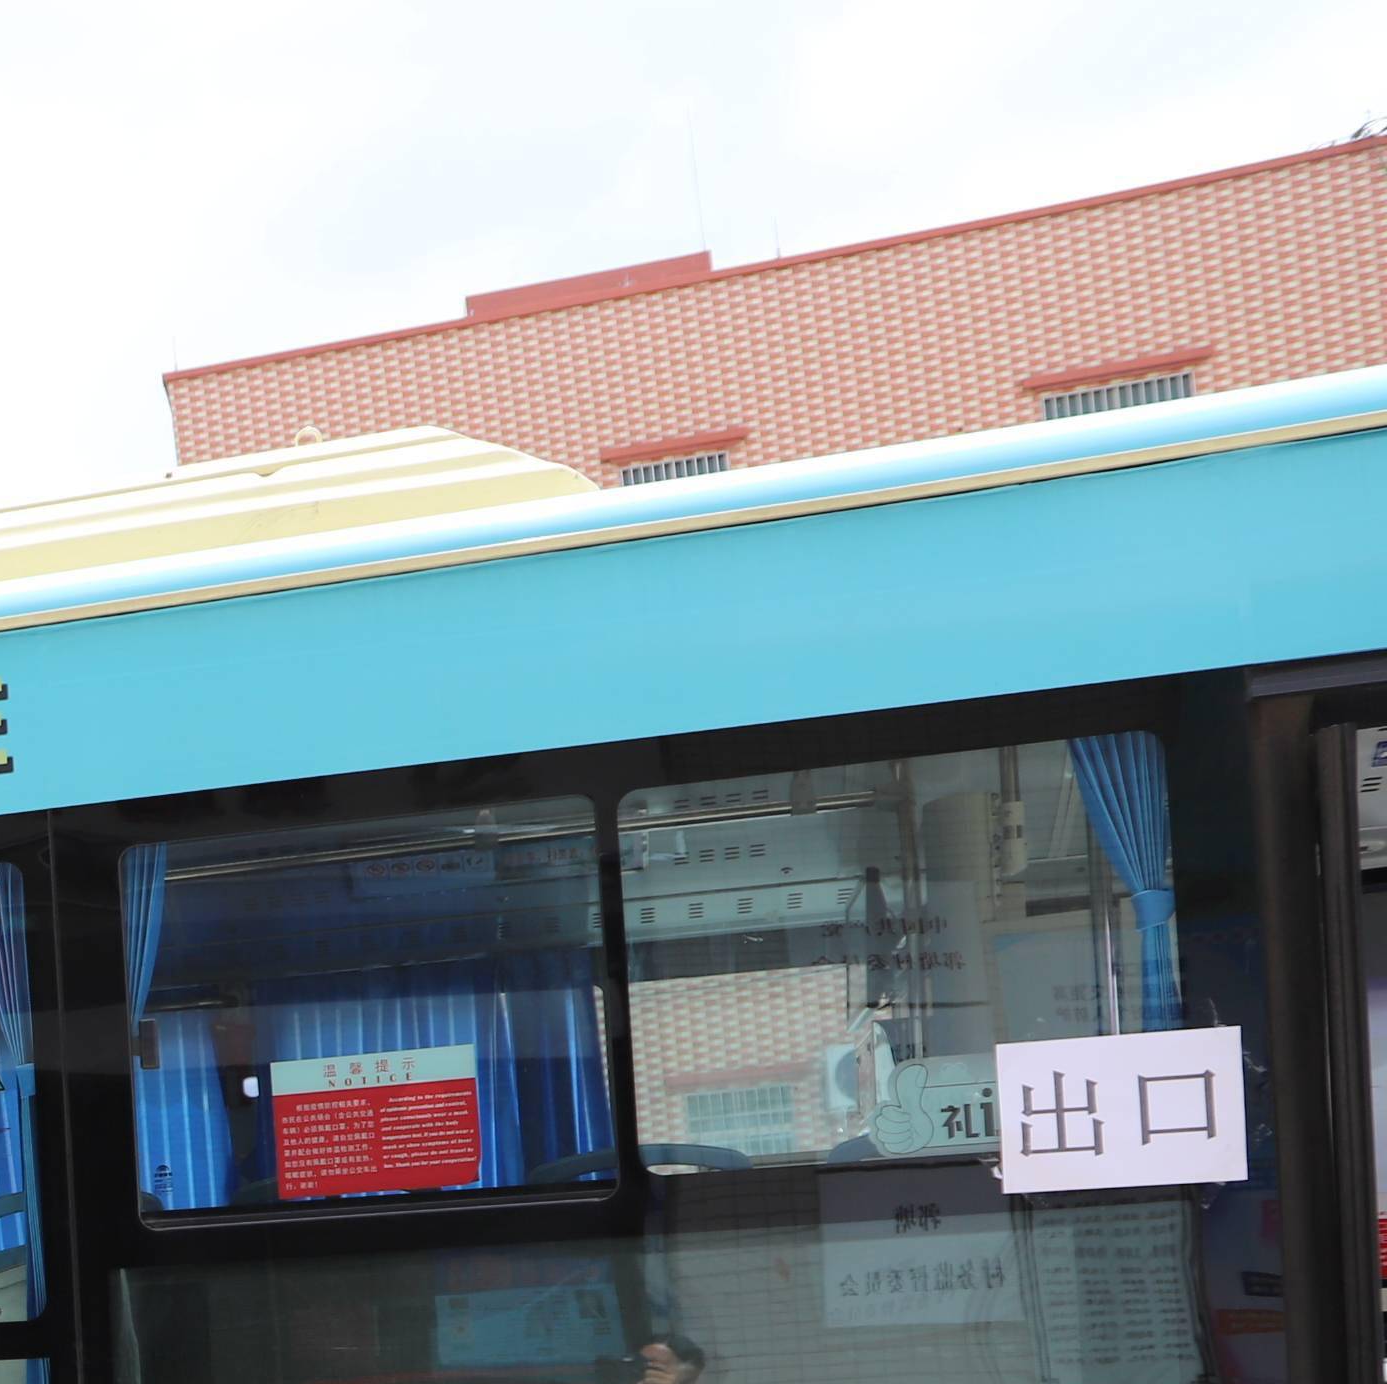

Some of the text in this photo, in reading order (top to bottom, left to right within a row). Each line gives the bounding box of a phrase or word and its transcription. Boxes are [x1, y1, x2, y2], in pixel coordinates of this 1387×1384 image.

[323, 1057, 415, 1078] 温馨提示
[329, 1072, 413, 1088] NOTICE
[1022, 1069, 1217, 1157] 出口
